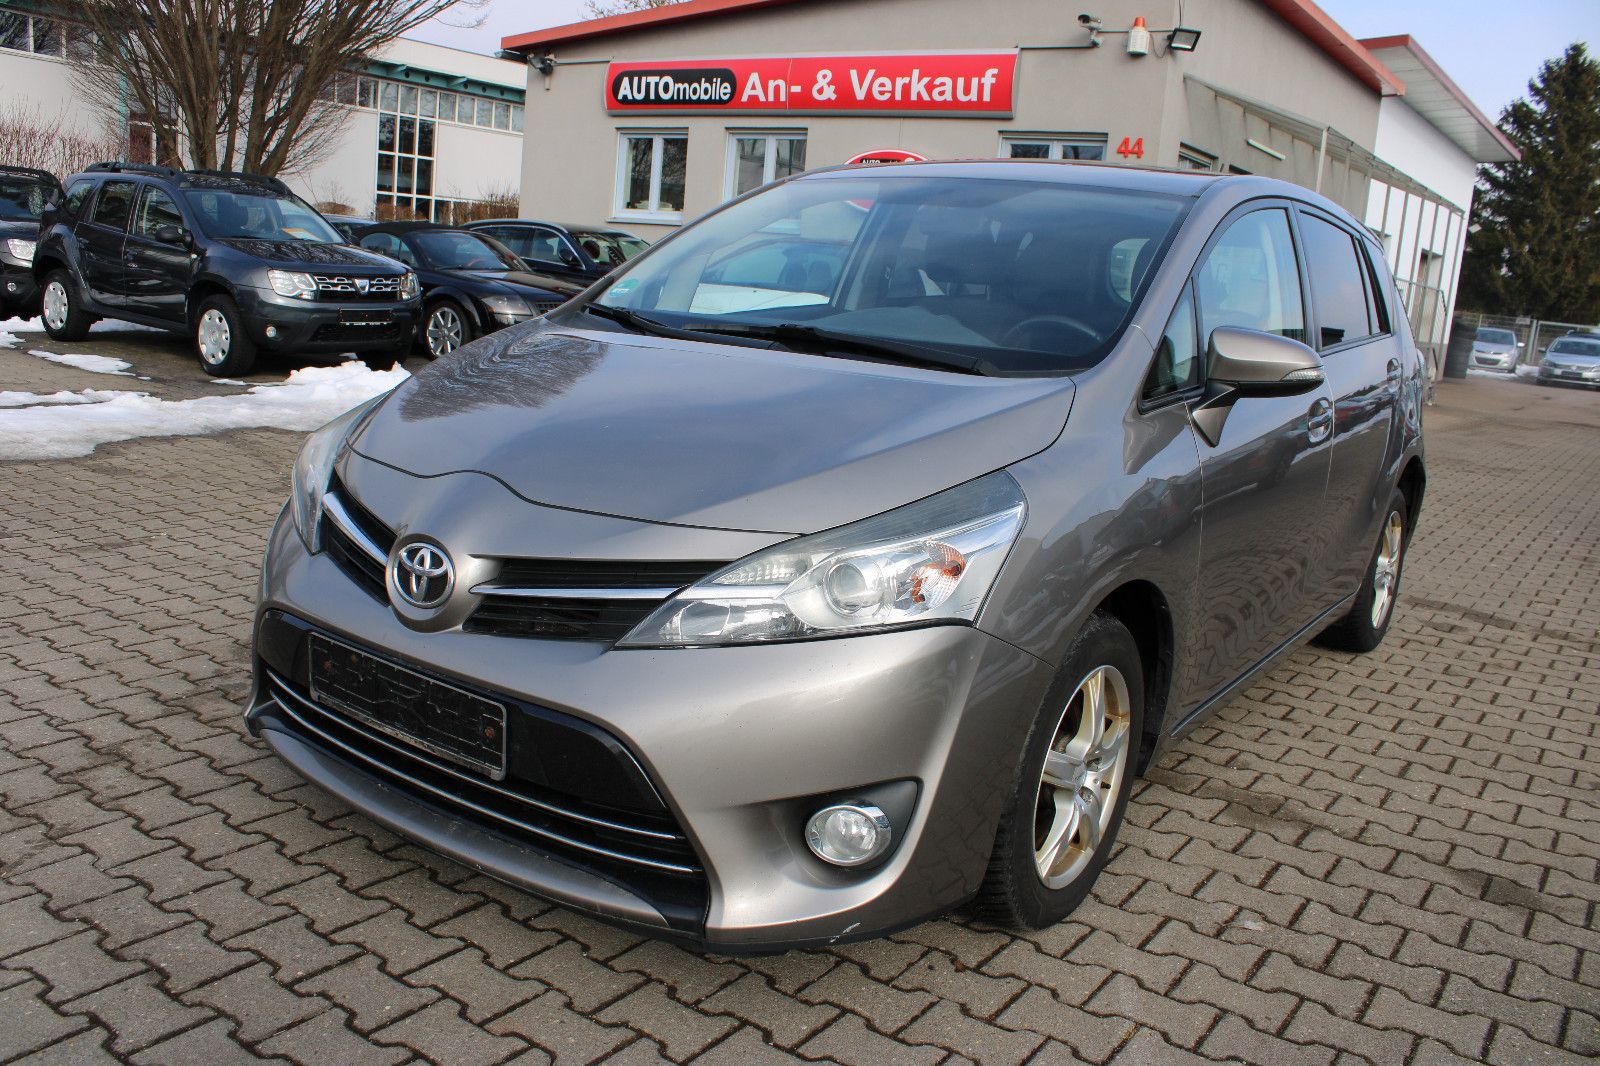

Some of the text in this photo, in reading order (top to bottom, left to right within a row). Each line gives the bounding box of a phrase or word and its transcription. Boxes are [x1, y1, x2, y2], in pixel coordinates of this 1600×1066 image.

[617, 68, 999, 102] AUTOmobile An- & Verkauf
[1116, 136, 1144, 159] 44
